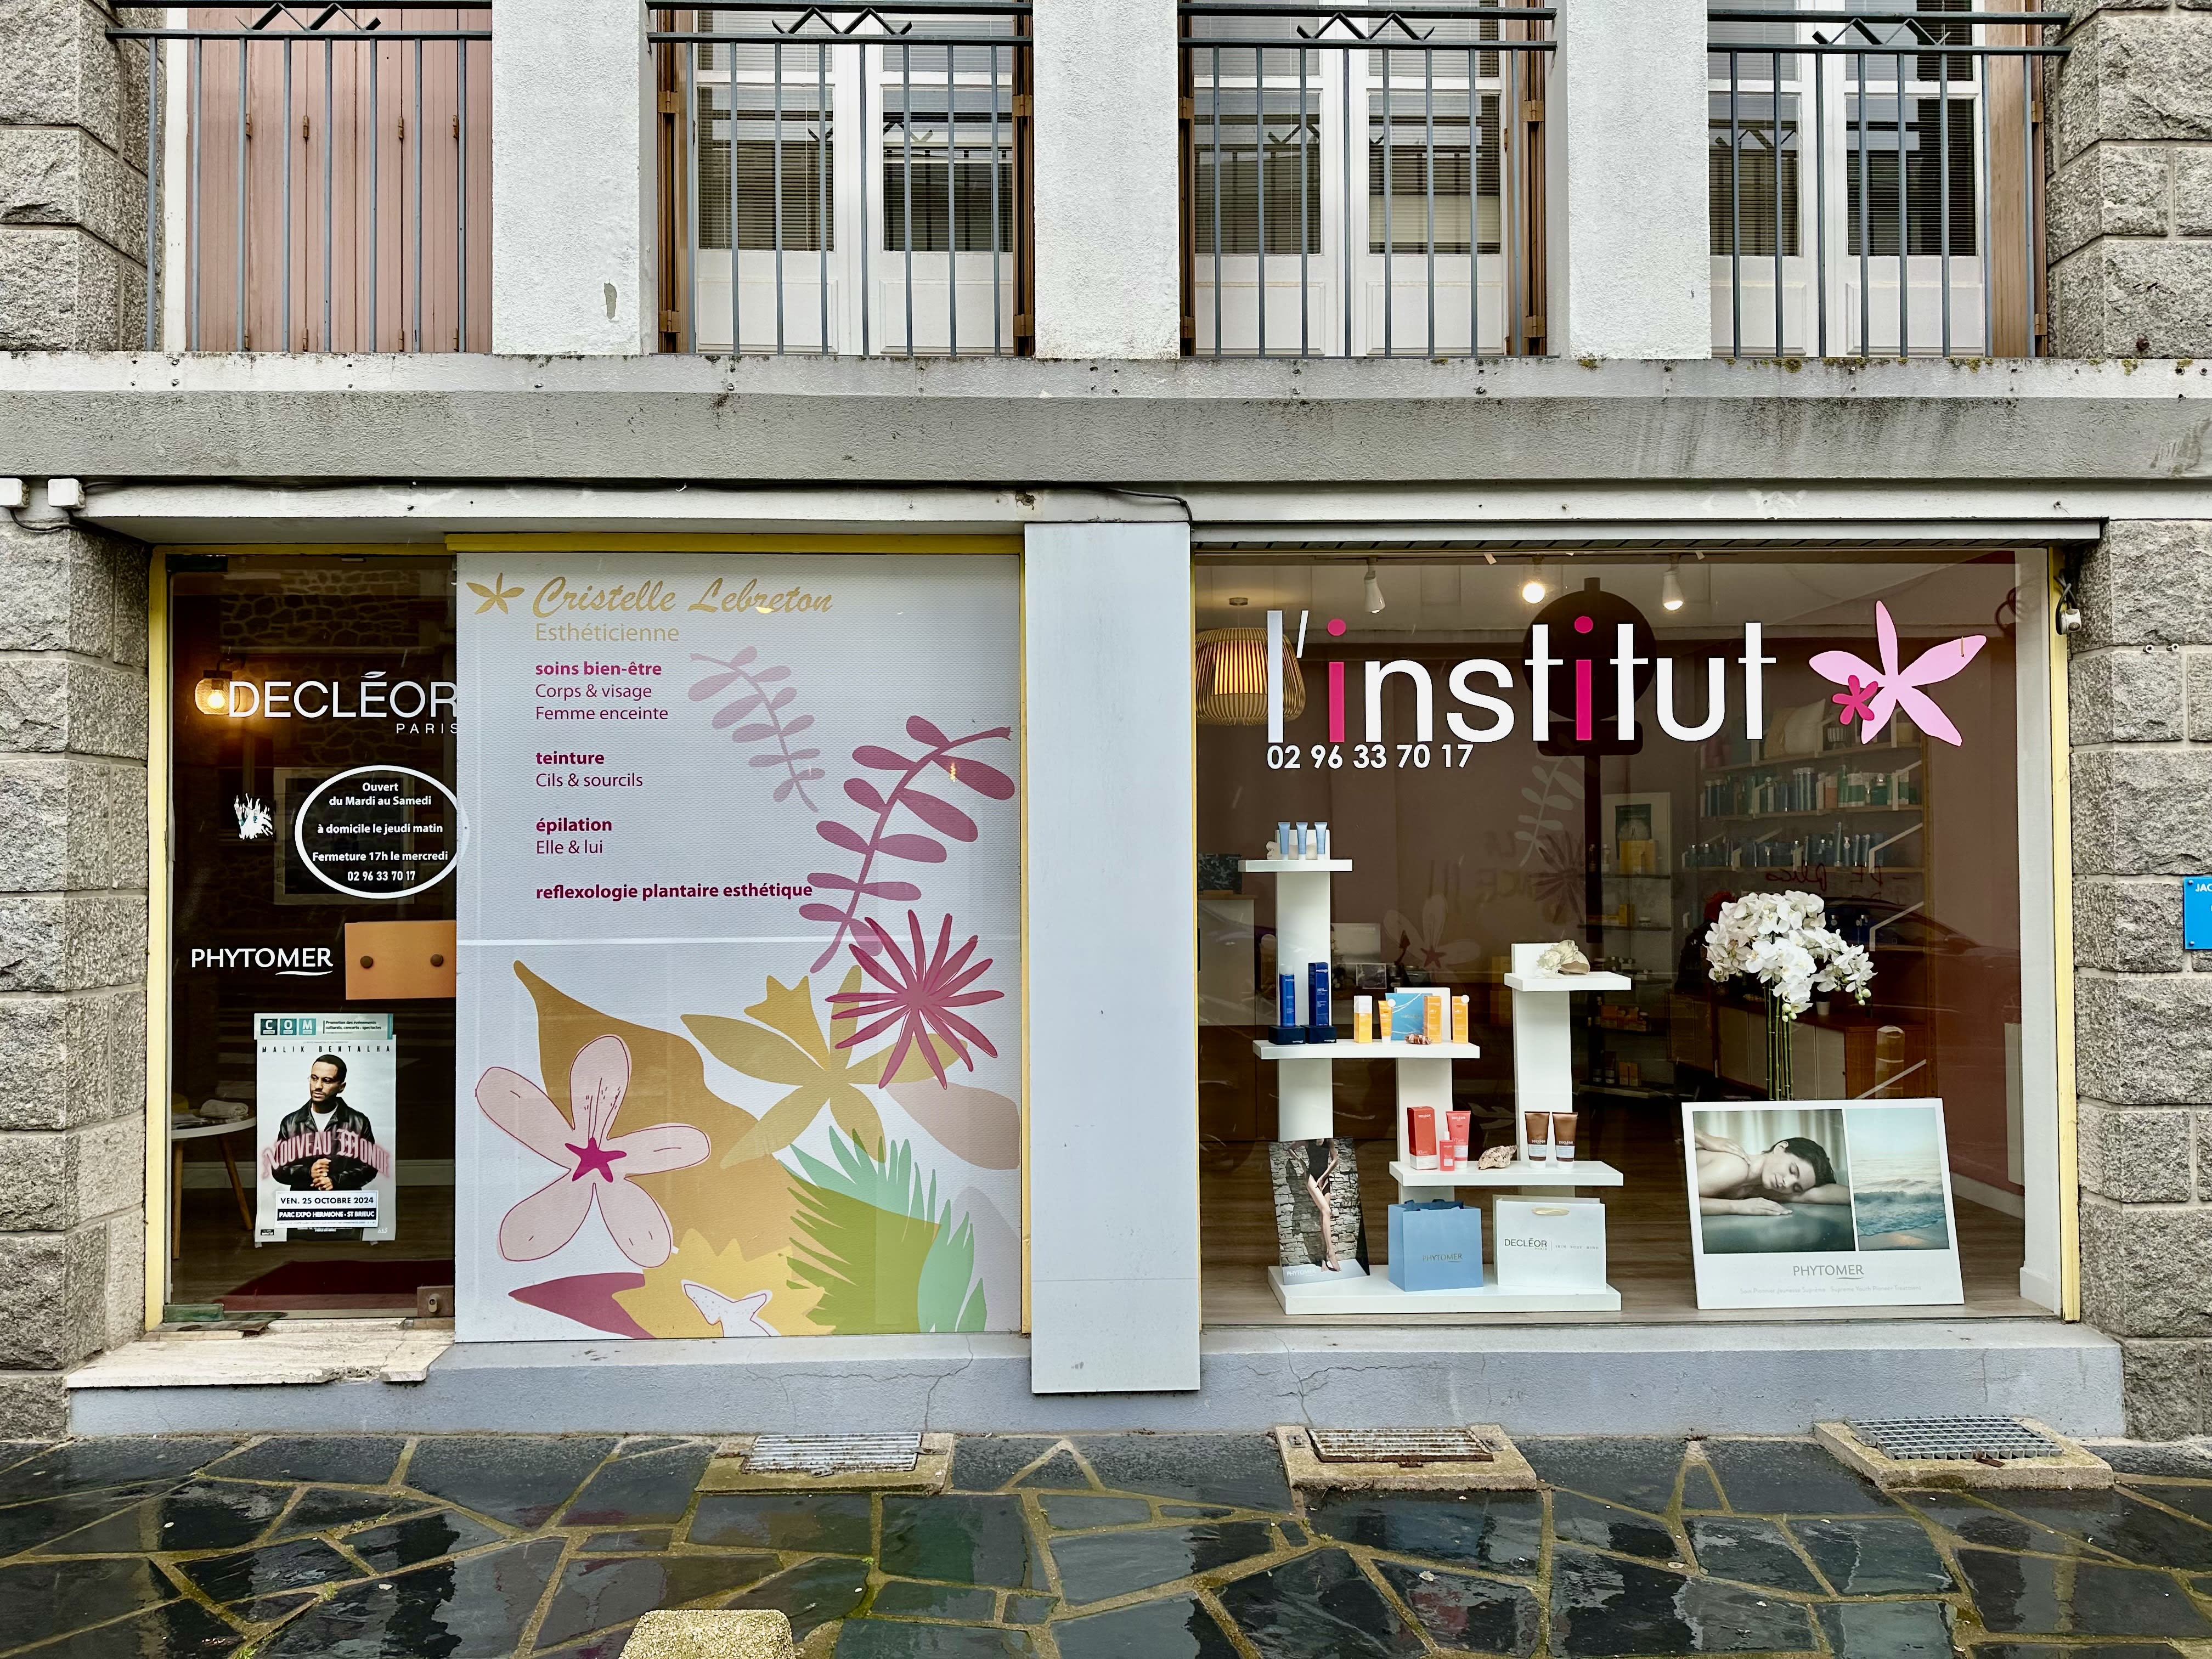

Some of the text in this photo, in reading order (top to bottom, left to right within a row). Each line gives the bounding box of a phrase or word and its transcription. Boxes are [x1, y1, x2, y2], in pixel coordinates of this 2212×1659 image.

[532, 576, 833, 618] Cristelle Lebreton
[535, 623, 679, 642] Esthéticienne
[535, 661, 662, 675] soins bien-être
[535, 684, 652, 701] Corps & visage
[536, 706, 668, 720] Femme enceinte
[396, 723, 457, 734] PARIS
[535, 751, 605, 765] teinture
[1267, 744, 1474, 769] 02 96 33 70 17
[536, 772, 643, 787] Cils & sourcils
[362, 782, 399, 792] Ouvert
[329, 796, 343, 806] du
[345, 795, 375, 805] Mardi
[392, 795, 431, 805] Samedi
[317, 823, 443, 836] à domicile le jeudi matin
[536, 817, 612, 833] épilation
[537, 839, 602, 854] Elle & lui
[312, 850, 448, 861] Fermeture 17h le mercredi
[347, 871, 416, 882] 02 96 33 70 17
[537, 882, 813, 902] reflexologie plantaire esthétique
[191, 947, 334, 968] PHYTOMER
[262, 1128, 390, 1179] NOUVEAU MONDE
[1504, 1238, 1547, 1247] DECLÉOR
[1422, 1253, 1463, 1261] PHYTOMER
[1286, 1268, 1317, 1277] PHYTOMER
[1793, 1265, 1865, 1276] PHYTOMER
